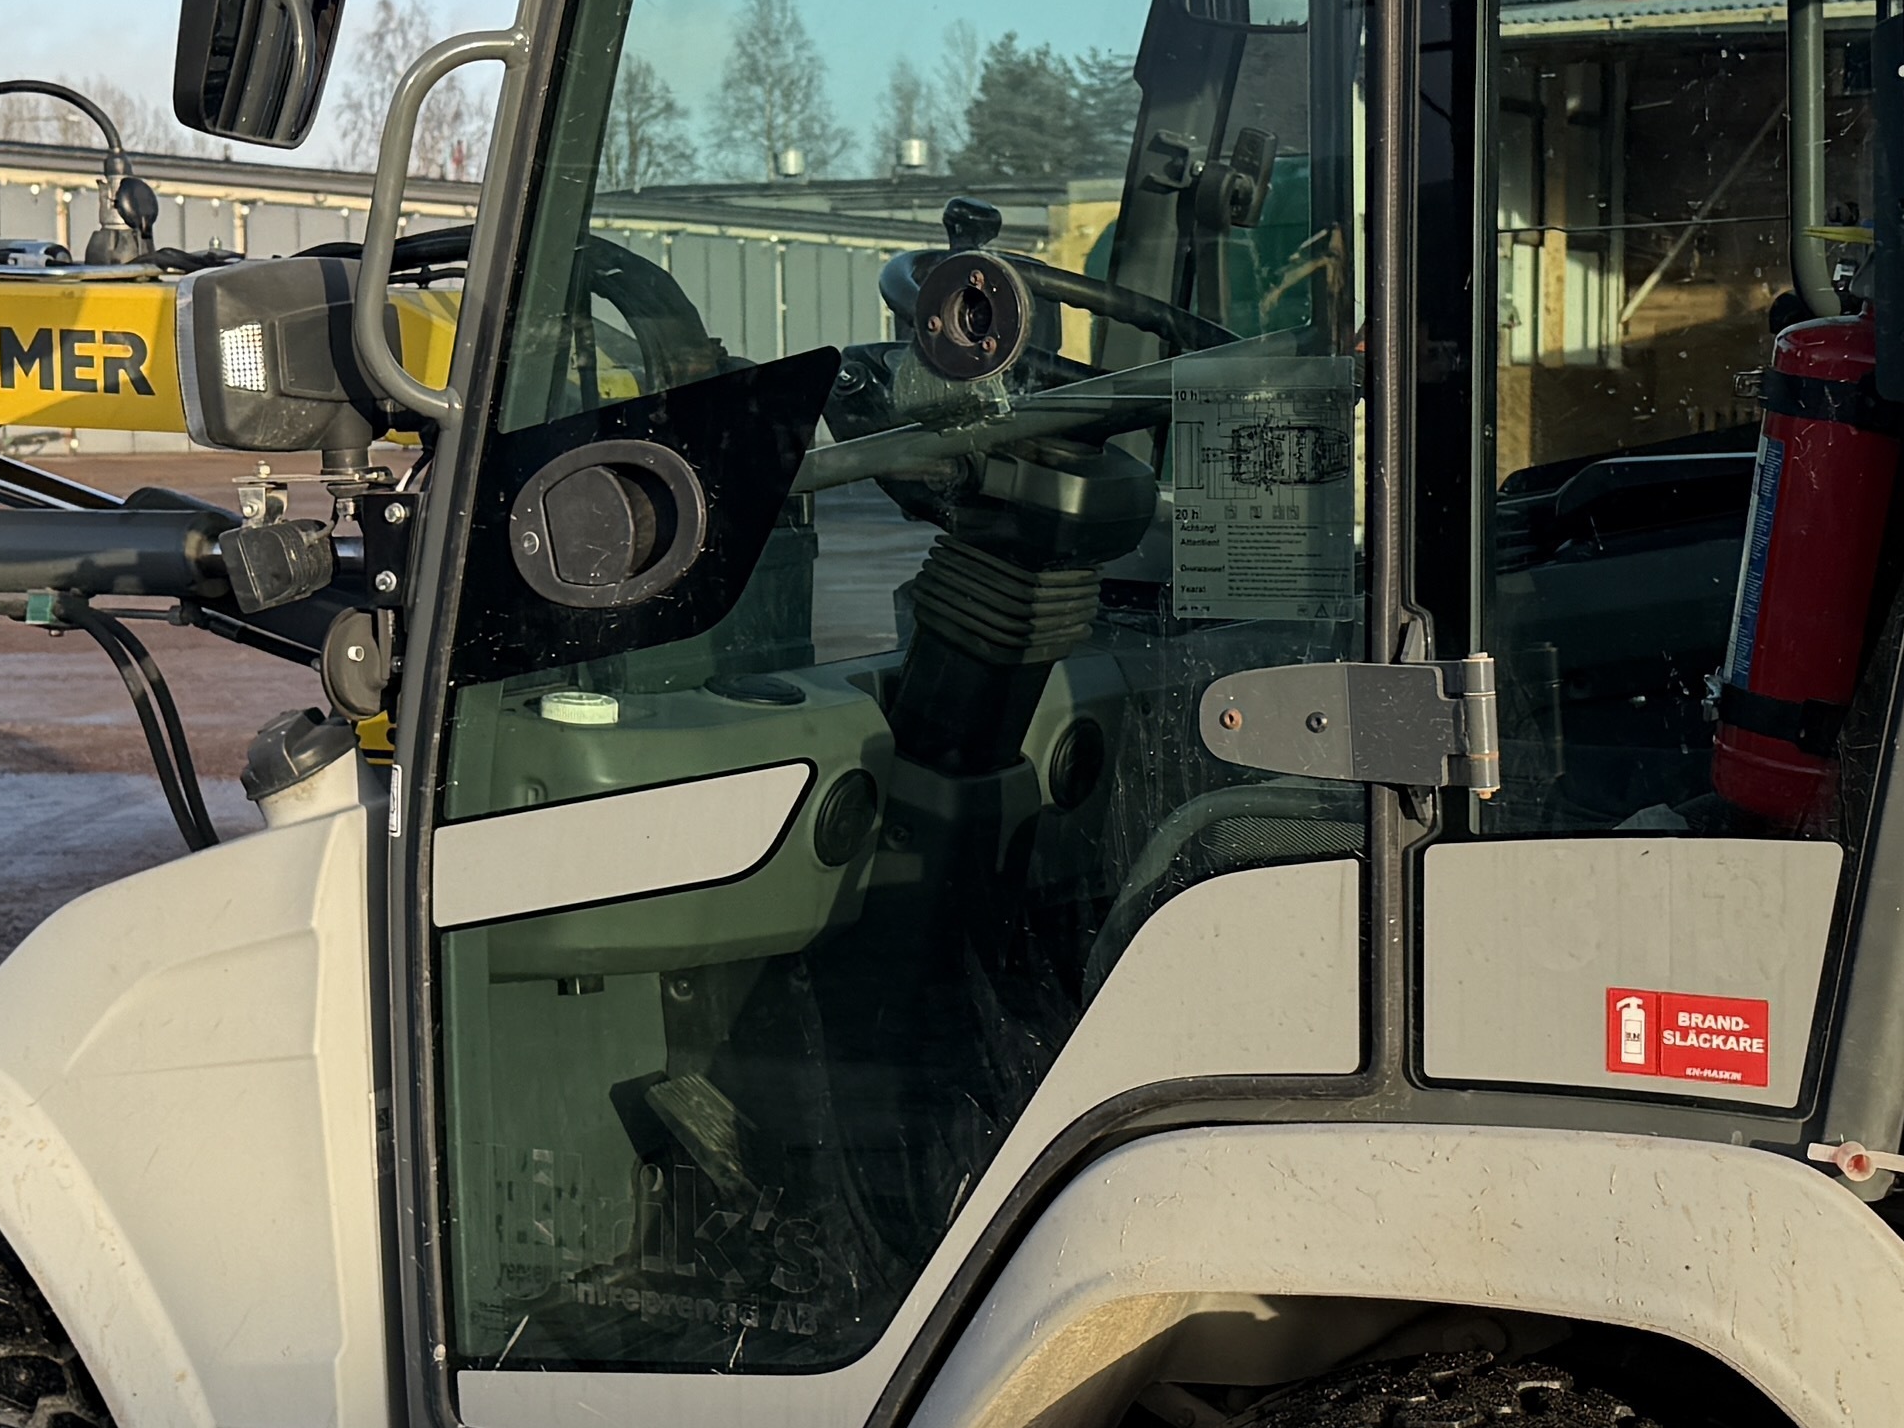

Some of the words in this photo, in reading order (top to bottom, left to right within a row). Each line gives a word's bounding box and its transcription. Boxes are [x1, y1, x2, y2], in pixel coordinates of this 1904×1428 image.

[1175, 509, 1188, 520] 20
[1678, 1011, 1749, 1032] BRAND-
[1662, 1029, 1765, 1054] SLÄCKARE
